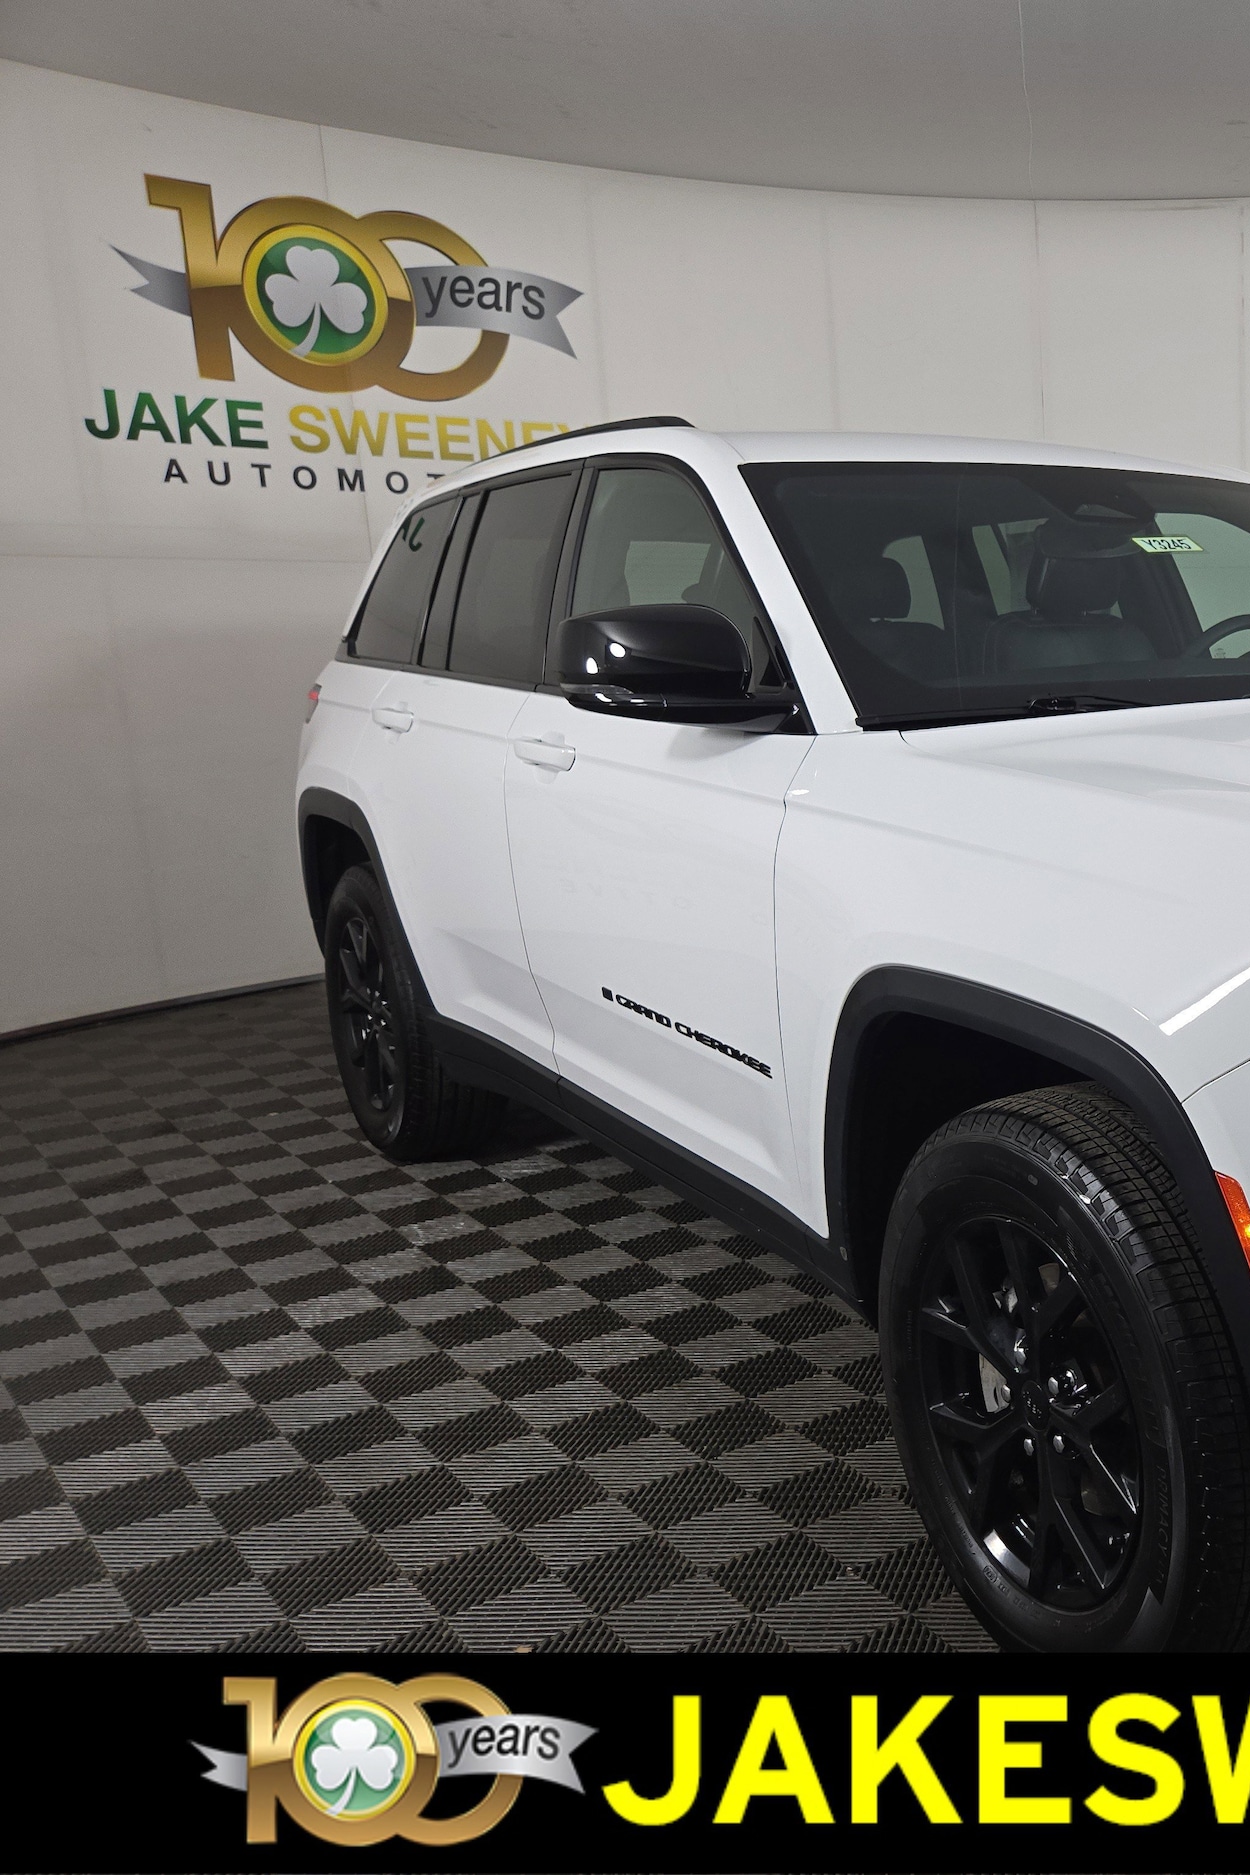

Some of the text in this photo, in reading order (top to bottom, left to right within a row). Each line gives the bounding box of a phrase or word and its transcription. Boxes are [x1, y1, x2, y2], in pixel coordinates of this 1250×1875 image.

[144, 173, 547, 401] 100 years
[84, 388, 597, 463] JAKE SWEEN
[1141, 539, 1192, 550] Y3245
[615, 994, 772, 1079] GRAND CHEROKEE
